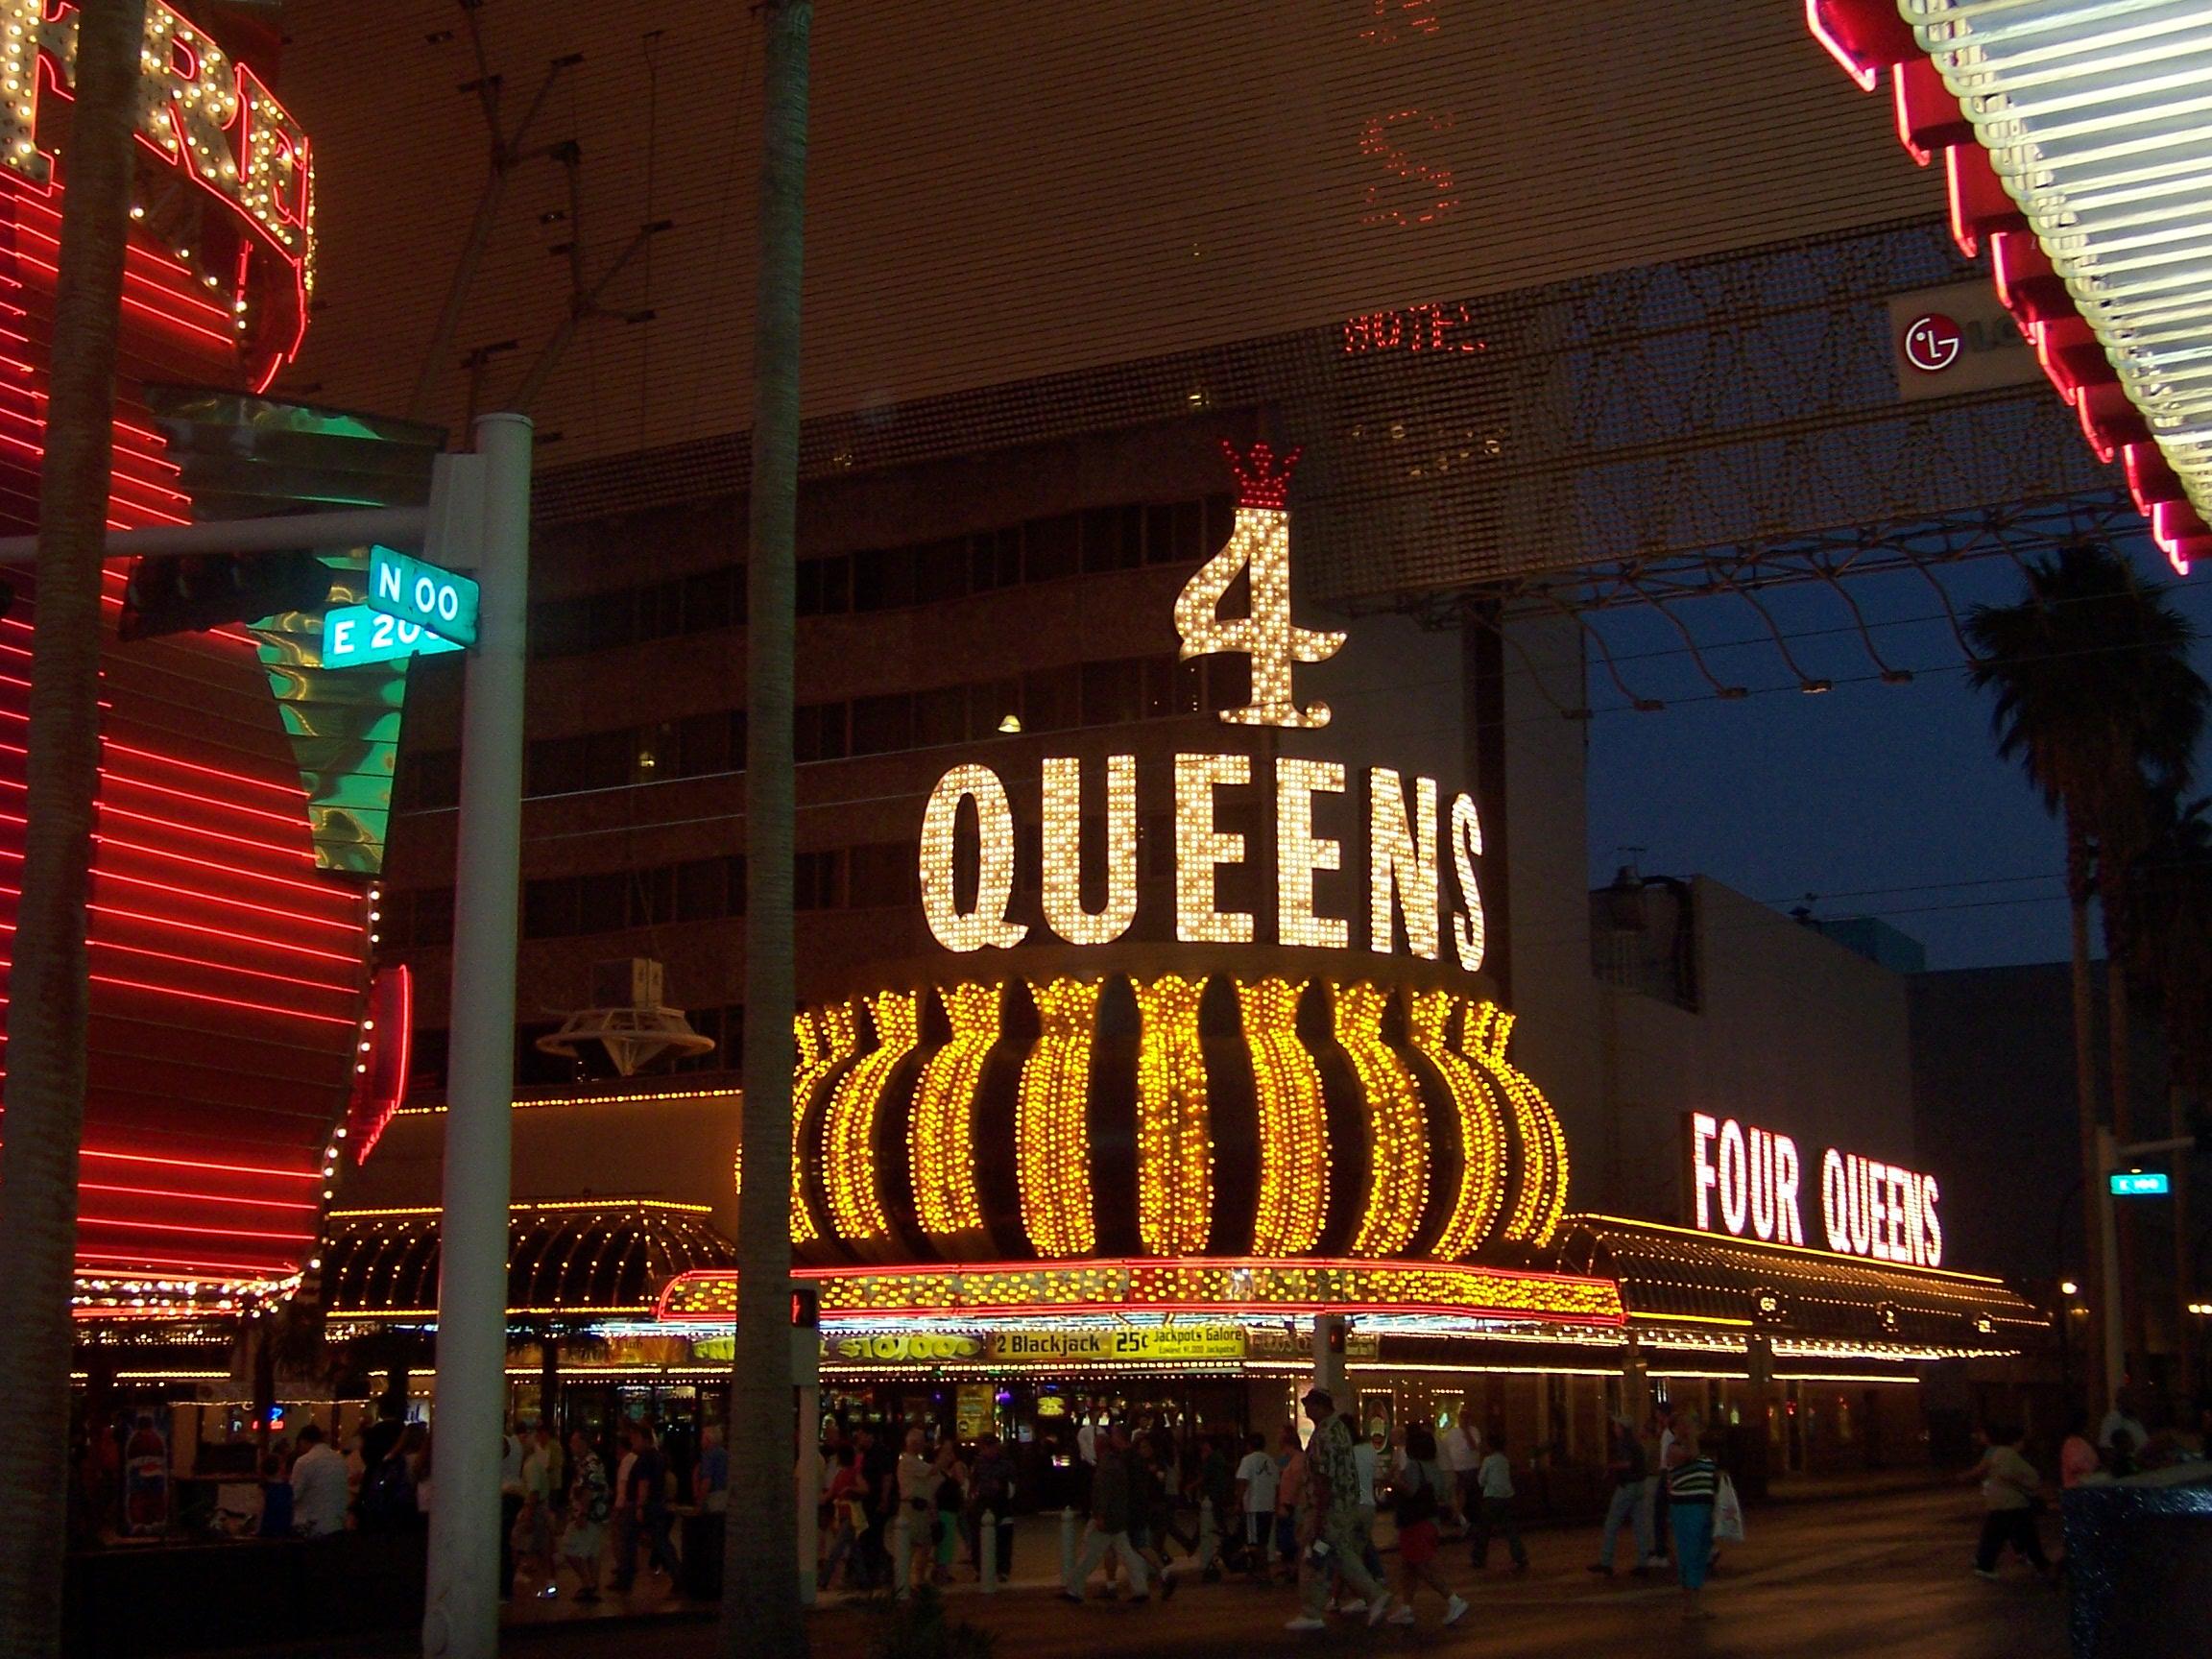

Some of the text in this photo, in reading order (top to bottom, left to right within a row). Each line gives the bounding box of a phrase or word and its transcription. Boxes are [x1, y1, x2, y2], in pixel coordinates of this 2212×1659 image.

[379, 563, 458, 621] N 00
[1174, 507, 1349, 730] 4
[334, 613, 439, 655] E 20
[918, 753, 1486, 973] QUEENS
[1693, 1112, 1943, 1268] FOUR QUEENS
[1012, 1334, 1101, 1357] Blackjack
[1153, 1331, 1202, 1344] Jackpots
[1206, 1327, 1242, 1341] Galore
